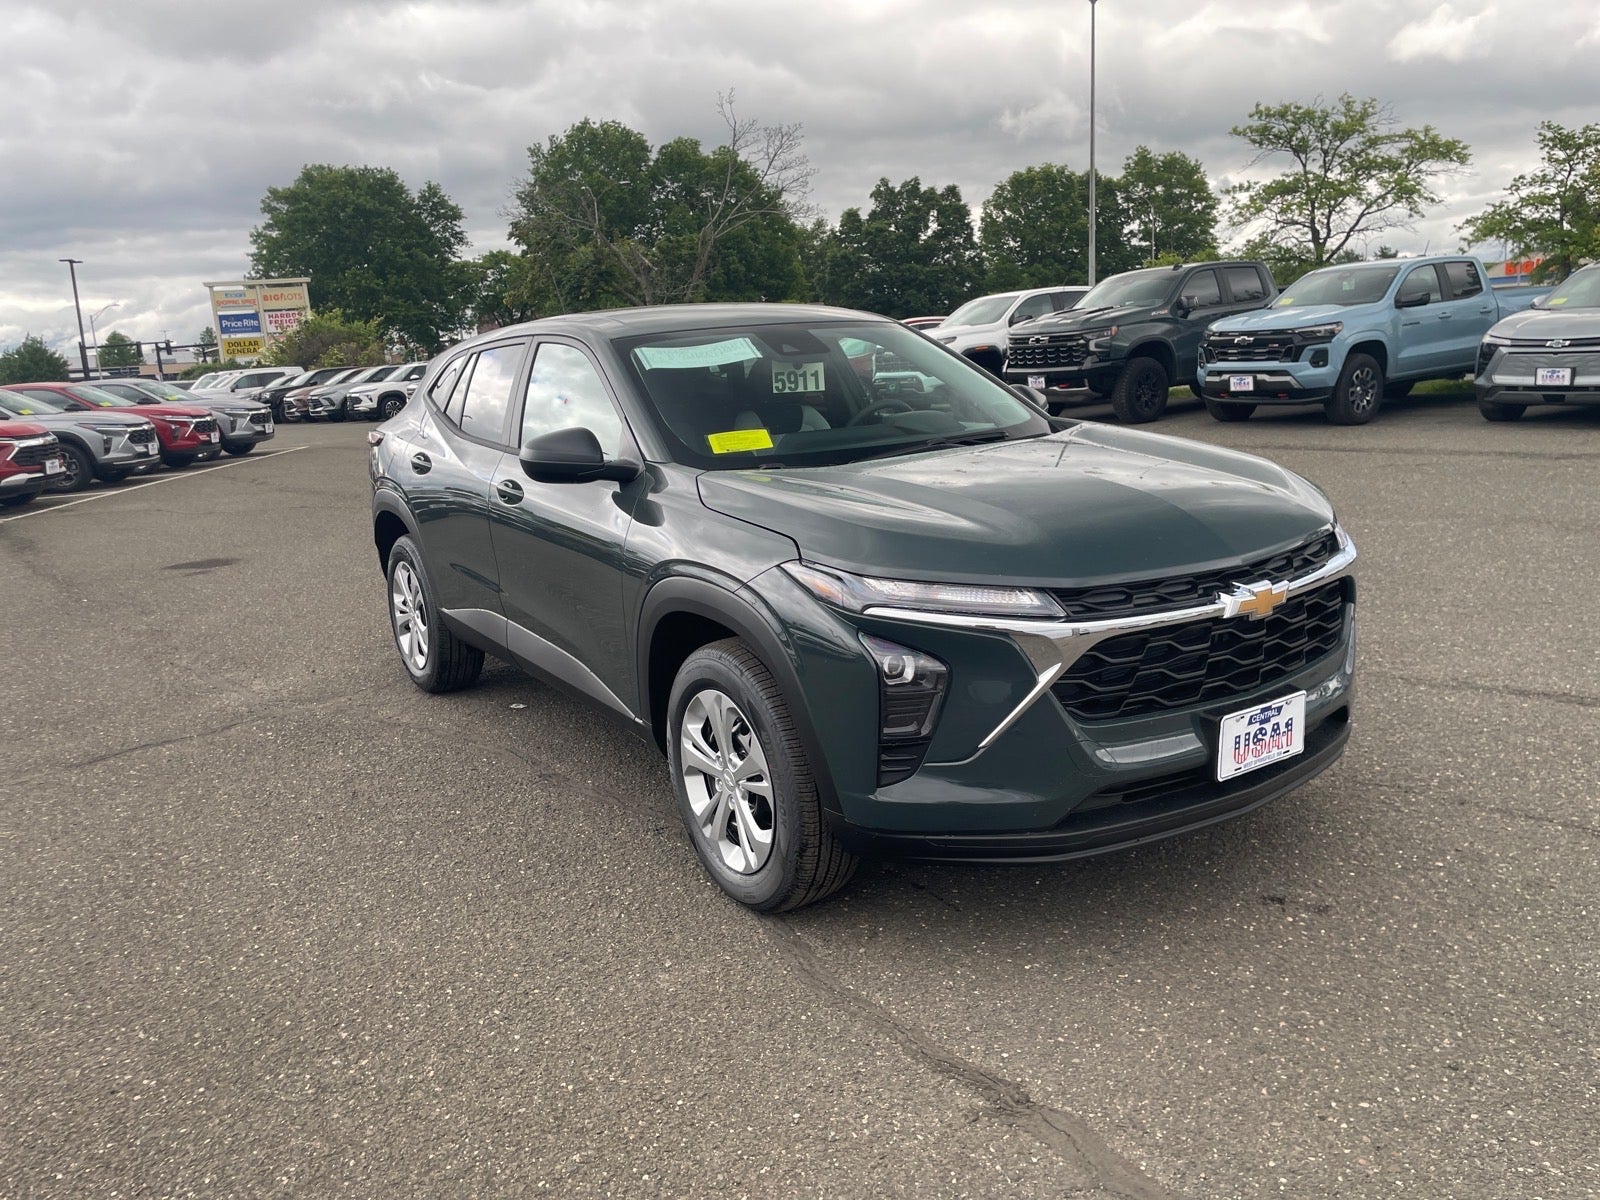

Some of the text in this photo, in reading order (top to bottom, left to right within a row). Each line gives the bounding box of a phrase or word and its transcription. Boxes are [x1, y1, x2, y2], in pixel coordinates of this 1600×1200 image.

[221, 320, 243, 328] Price
[227, 340, 259, 348] DOLLAR
[226, 347, 260, 355] GENERA
[774, 370, 820, 392] 5911
[1251, 708, 1279, 723] CENTRAL
